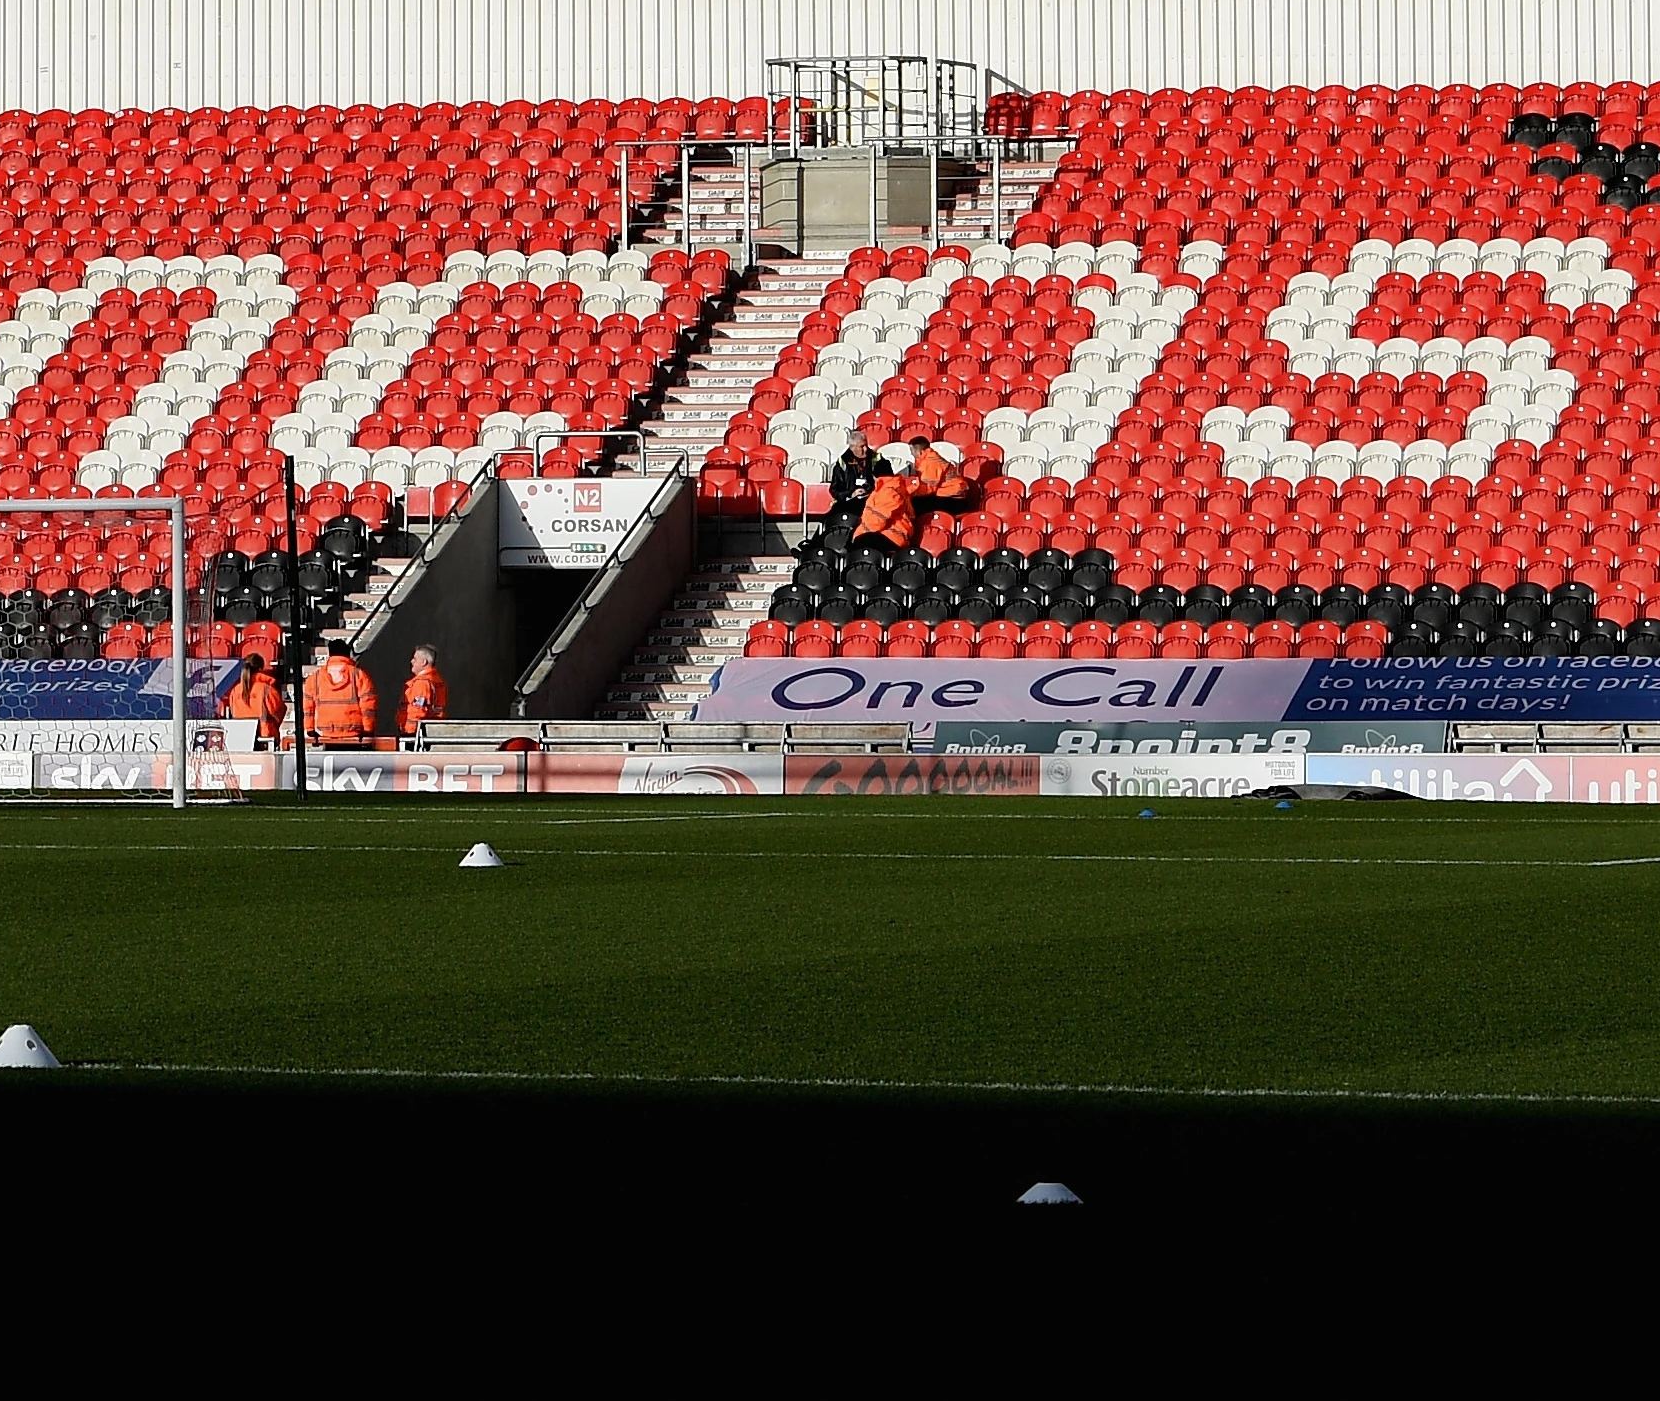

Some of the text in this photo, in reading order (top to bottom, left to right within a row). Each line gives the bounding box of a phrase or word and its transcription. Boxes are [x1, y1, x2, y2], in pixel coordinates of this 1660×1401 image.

[574, 485, 601, 508] N2
[551, 517, 628, 534] CORSAN
[1455, 657, 1493, 668] us
[1503, 657, 1546, 668] on
[27, 677, 129, 694] prizes
[771, 666, 1224, 710] One Call
[1318, 675, 1354, 690] to
[1364, 675, 1425, 690] win
[1435, 673, 1591, 690] fantastic
[1305, 694, 1570, 714] on match days!
[55, 732, 161, 752] HOMES
[293, 756, 382, 791] sky
[408, 764, 504, 792] BET
[634, 762, 683, 792] Virgin
[1133, 766, 1169, 776] Number
[1091, 770, 1251, 797] Stoneacre
[1336, 769, 1495, 801] tilita
